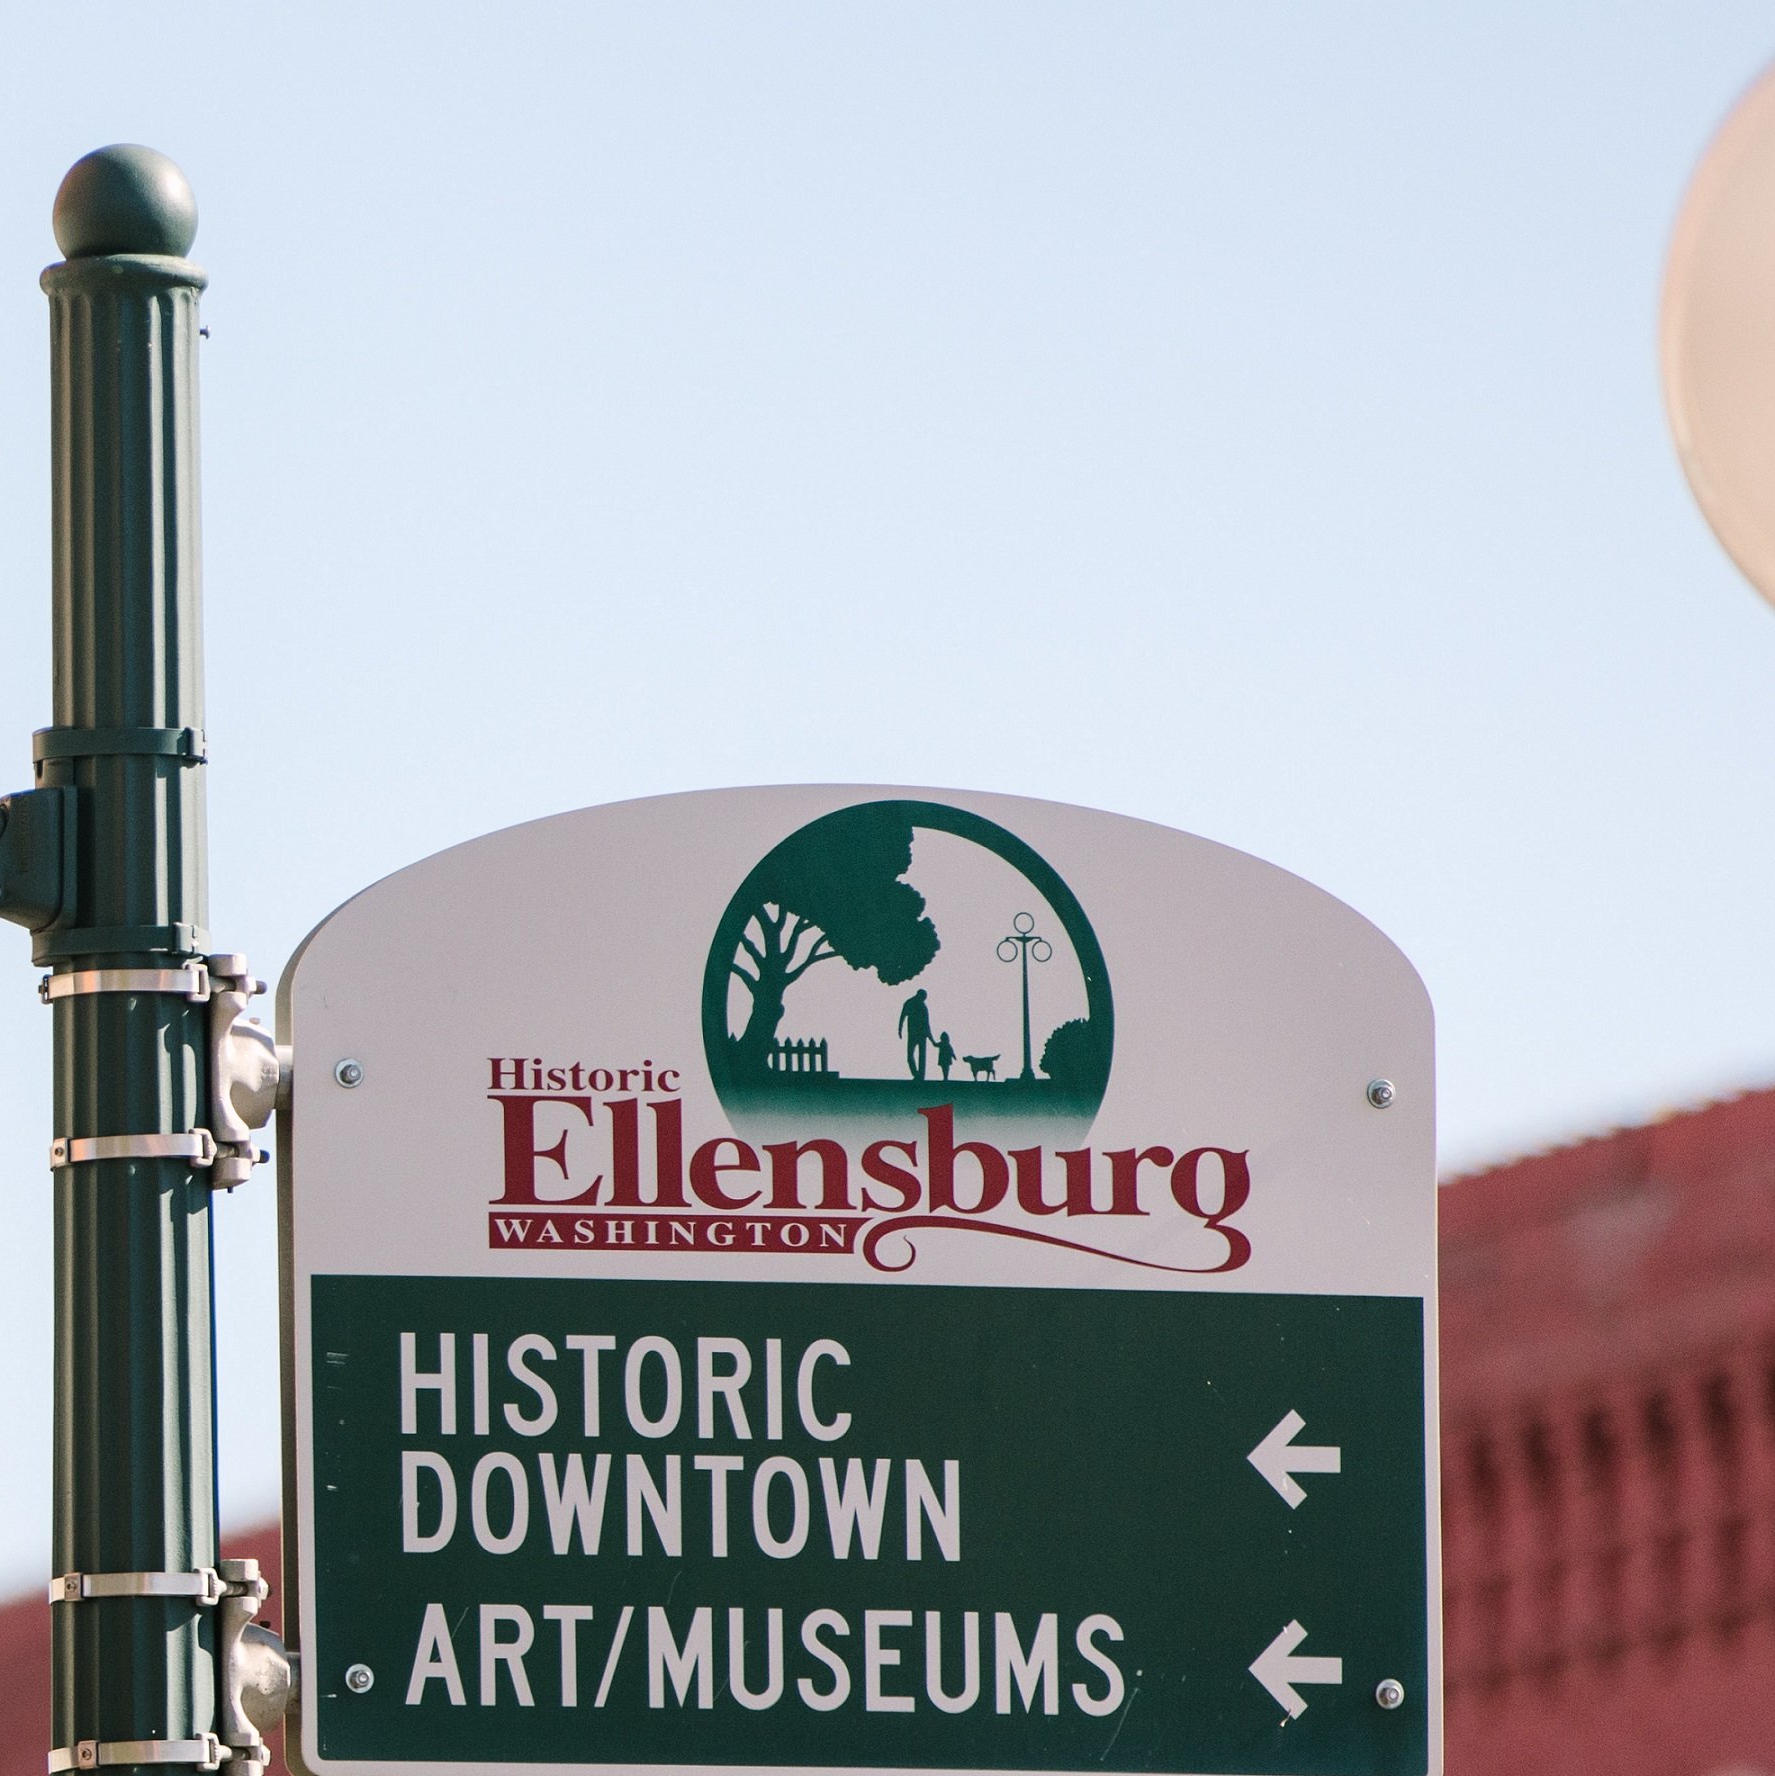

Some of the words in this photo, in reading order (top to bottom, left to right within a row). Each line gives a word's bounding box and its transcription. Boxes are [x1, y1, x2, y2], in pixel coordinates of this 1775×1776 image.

[486, 1057, 681, 1093] Historic
[487, 1094, 1253, 1273] Ellensburg
[493, 1218, 849, 1248] WASHINGTON
[399, 1332, 852, 1443] HISTORIC
[400, 1450, 961, 1562] DOWNTOWN
[405, 1603, 1126, 1718] ART/MUSEUMS
